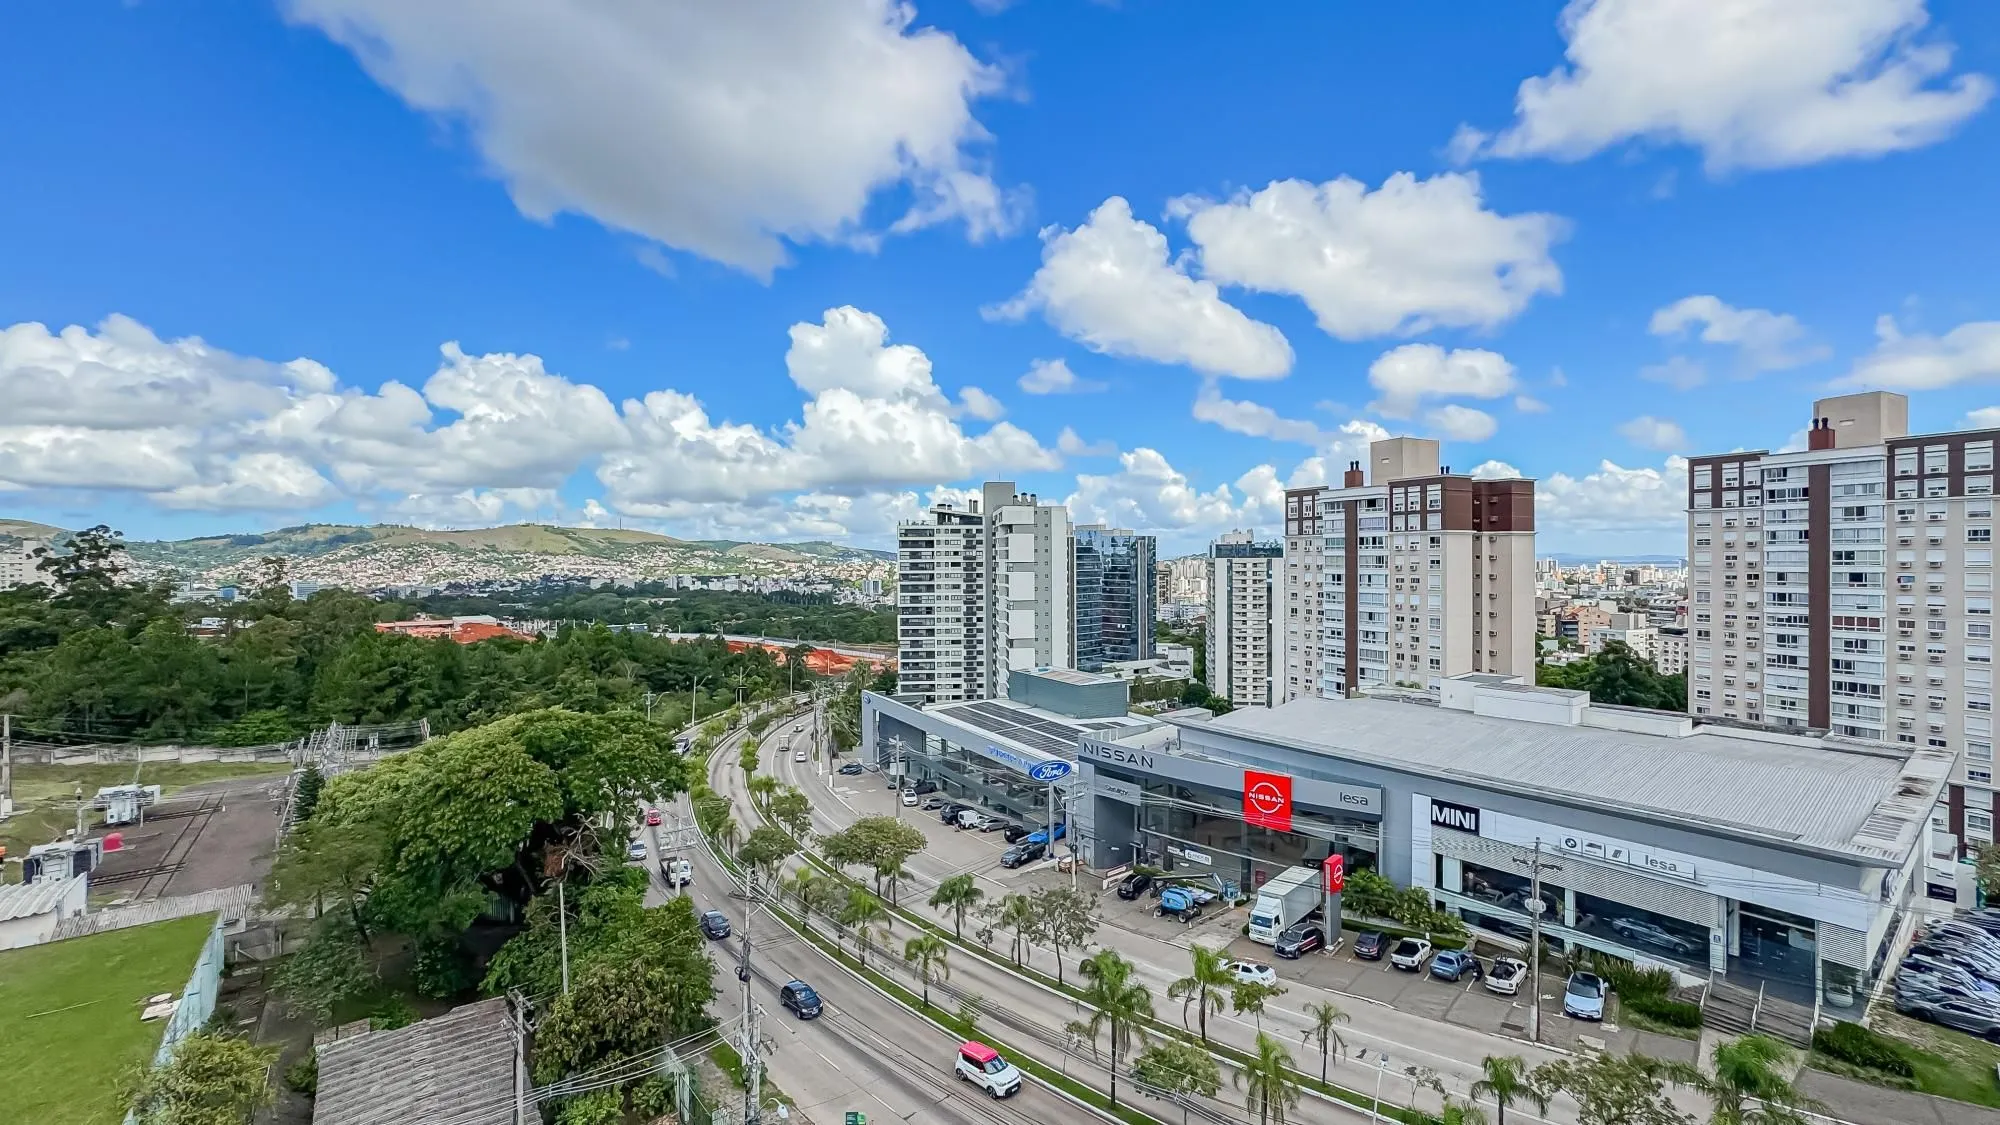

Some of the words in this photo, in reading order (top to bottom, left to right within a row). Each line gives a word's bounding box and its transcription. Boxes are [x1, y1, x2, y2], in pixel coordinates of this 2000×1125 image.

[1083, 742, 1153, 768] NISSAN
[1039, 764, 1065, 778] Ford
[1248, 792, 1285, 804] NISSAN
[1432, 804, 1476, 830] MINI
